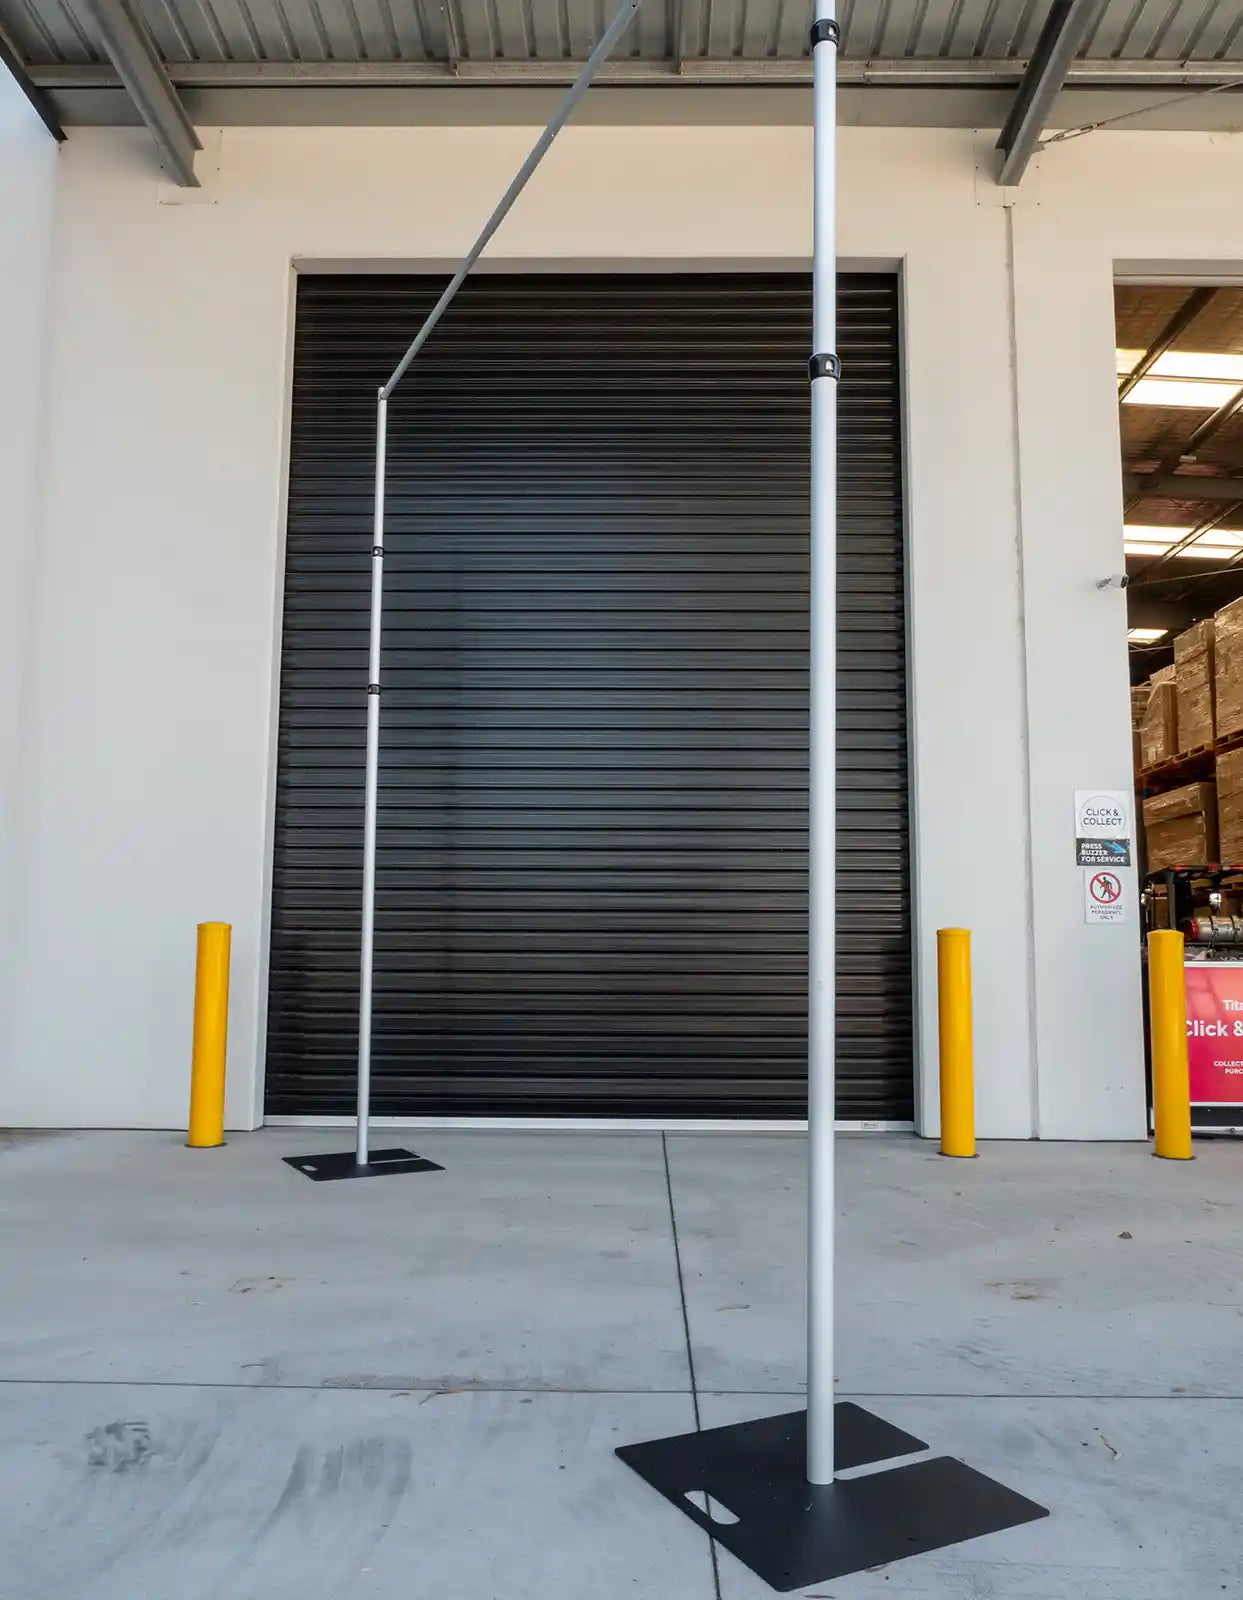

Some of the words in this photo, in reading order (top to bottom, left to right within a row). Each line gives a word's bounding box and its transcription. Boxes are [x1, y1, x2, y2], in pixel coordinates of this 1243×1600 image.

[1086, 808, 1112, 816] CLICK
[1113, 808, 1119, 816] &
[1083, 817, 1122, 825] COLLECT
